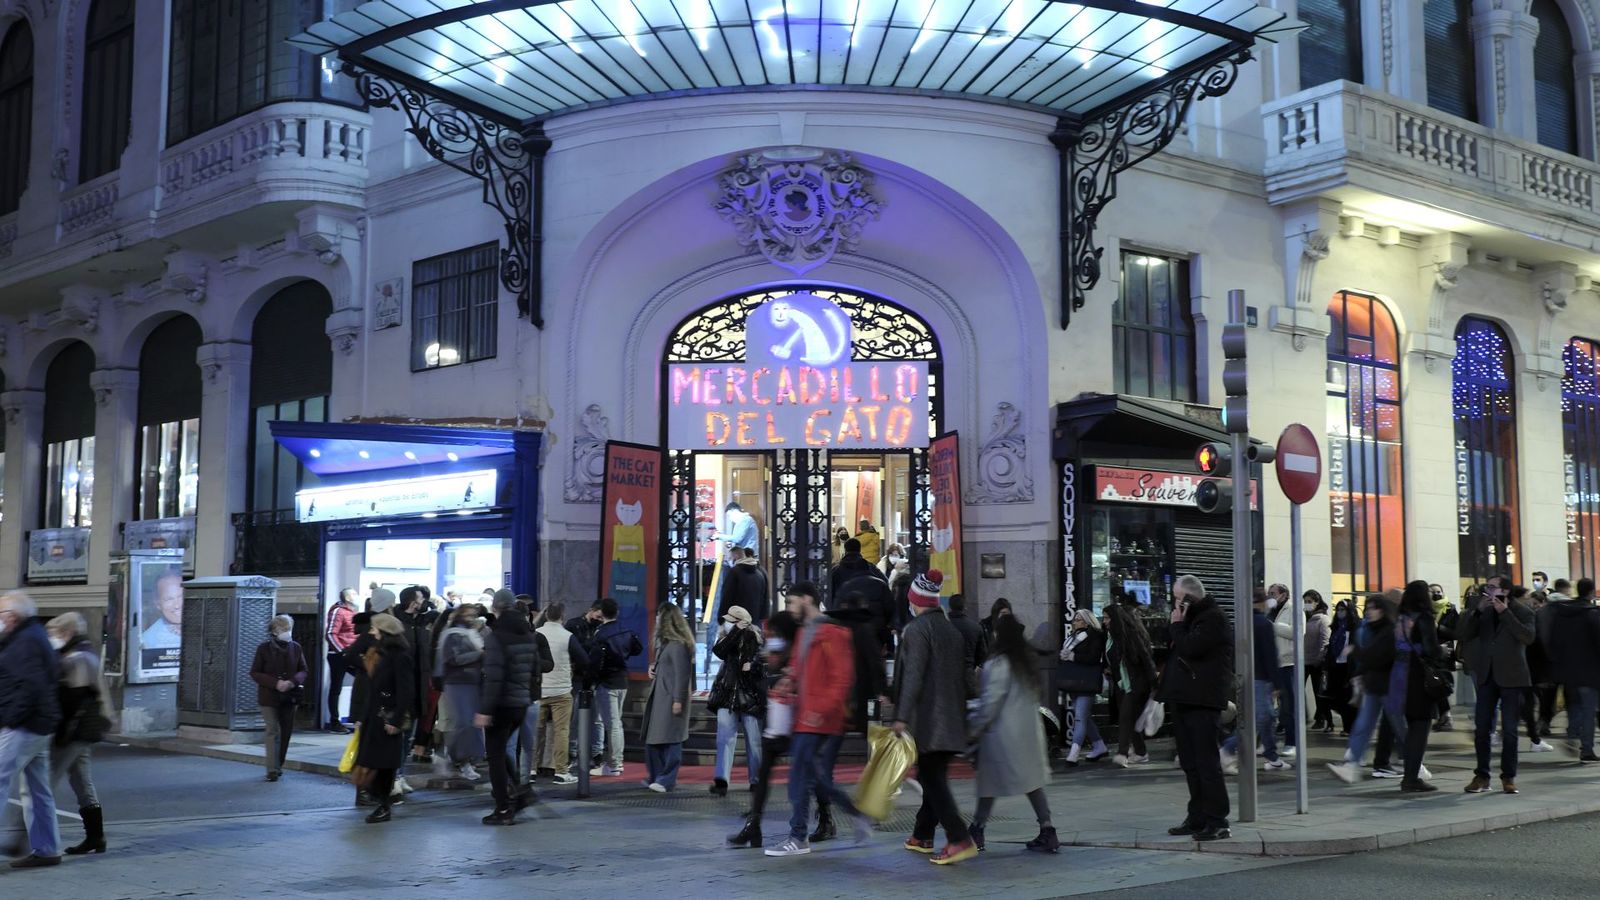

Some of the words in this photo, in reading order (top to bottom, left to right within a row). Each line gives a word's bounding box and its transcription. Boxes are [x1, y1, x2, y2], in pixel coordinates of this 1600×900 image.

[672, 365, 919, 405] MERCADILLO
[706, 411, 785, 446] DEL
[805, 405, 912, 446] GATO
[611, 472, 655, 488] MARKET
[612, 456, 633, 471] THE
[634, 460, 655, 474] CAT
[1456, 439, 1470, 535] kutxabank
[1063, 463, 1076, 621] SOUVENIRS
